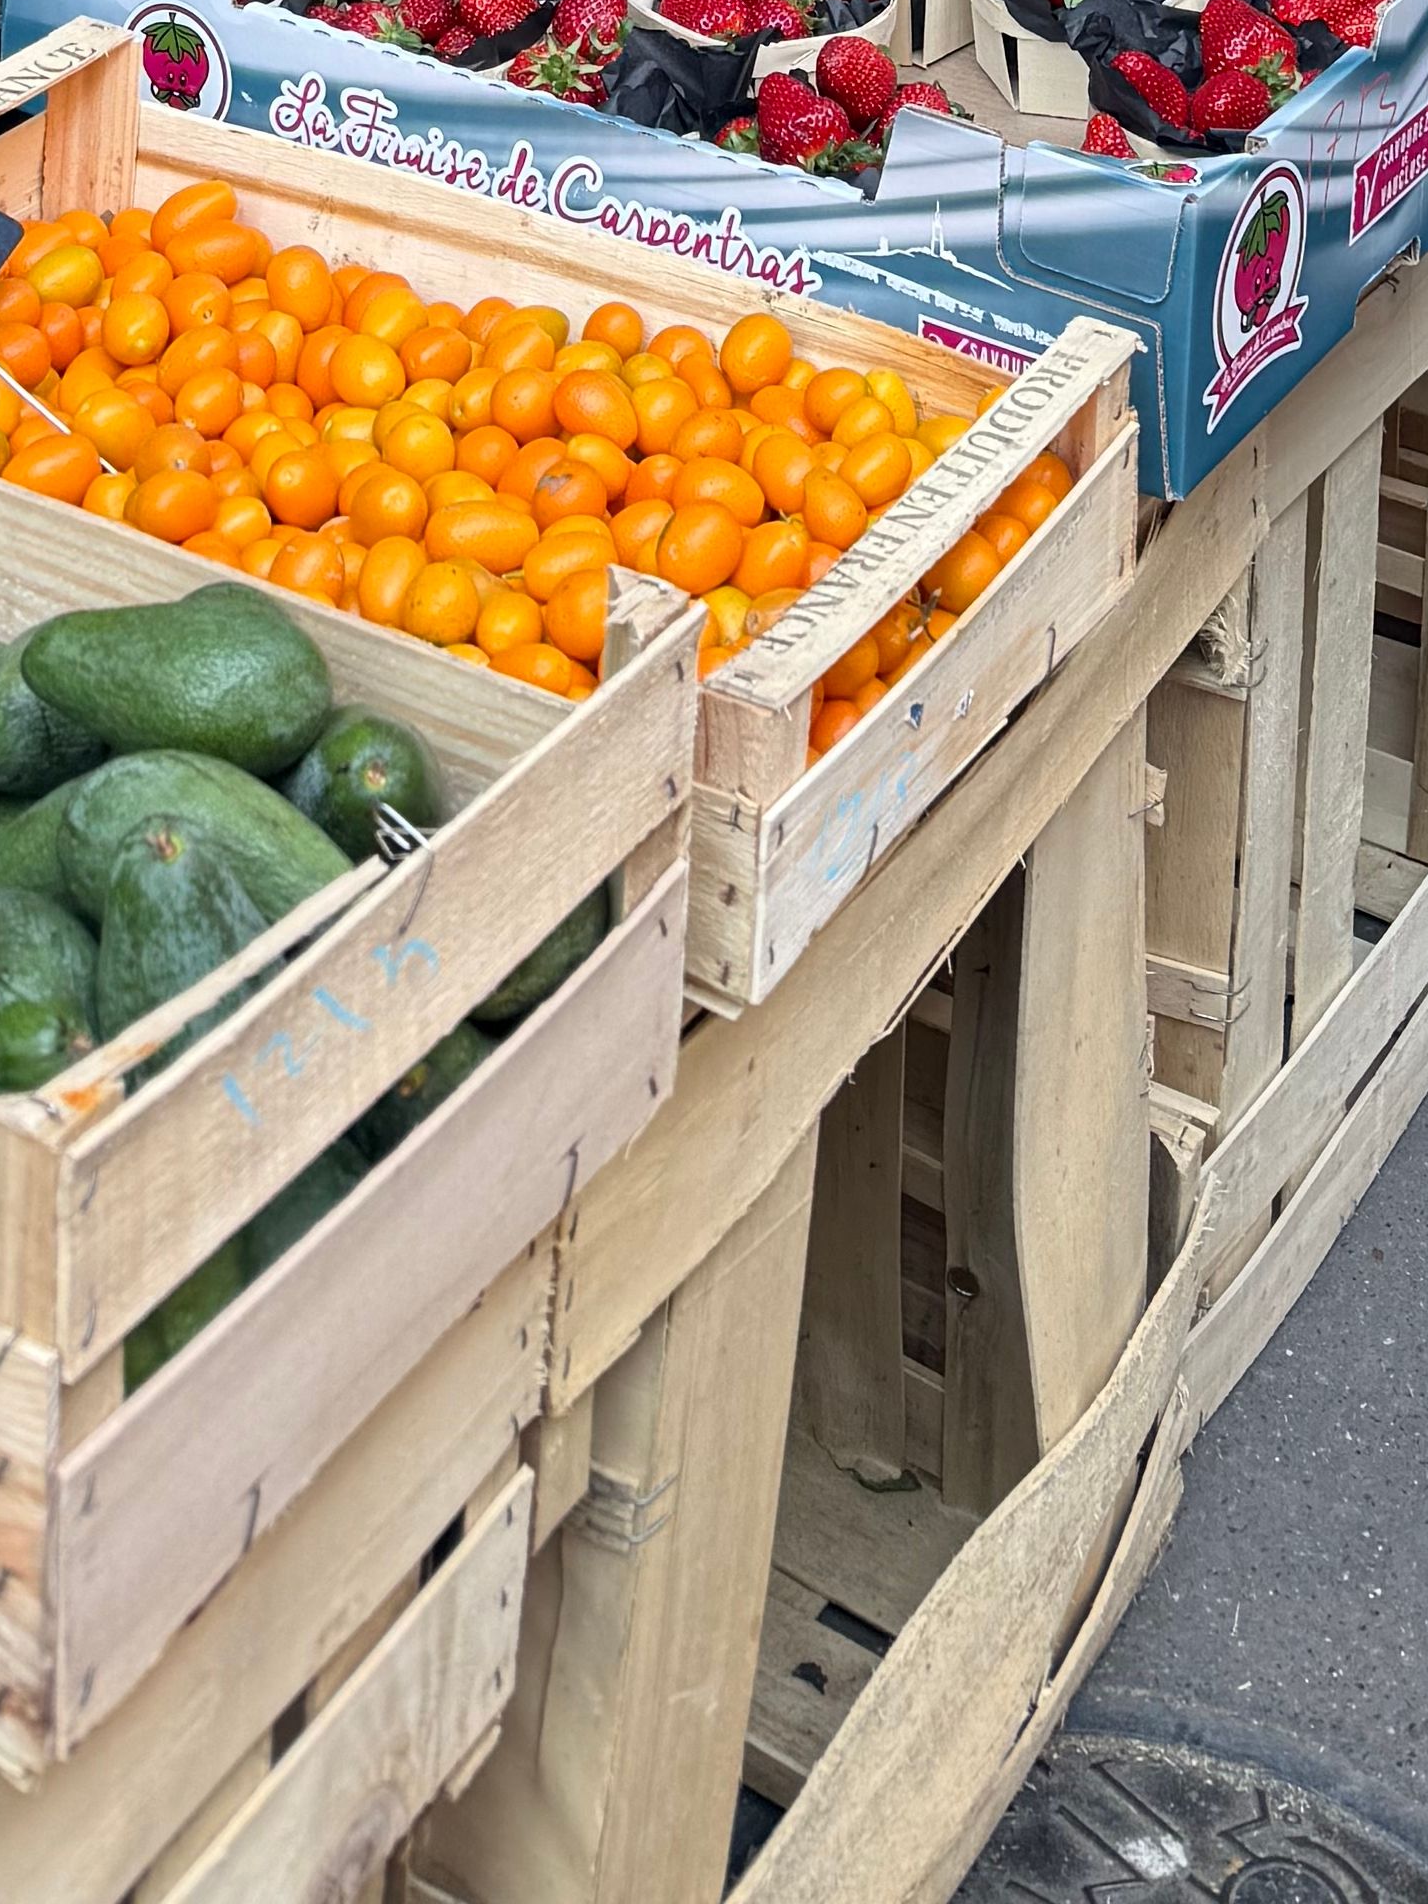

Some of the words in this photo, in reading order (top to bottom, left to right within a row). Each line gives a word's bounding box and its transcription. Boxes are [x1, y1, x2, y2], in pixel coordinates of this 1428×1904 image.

[275, 79, 339, 148] La
[346, 94, 487, 194] Fraise
[493, 147, 548, 210] de
[1380, 147, 1428, 207] VAUCLUSE
[761, 534, 894, 656] FRANCE
